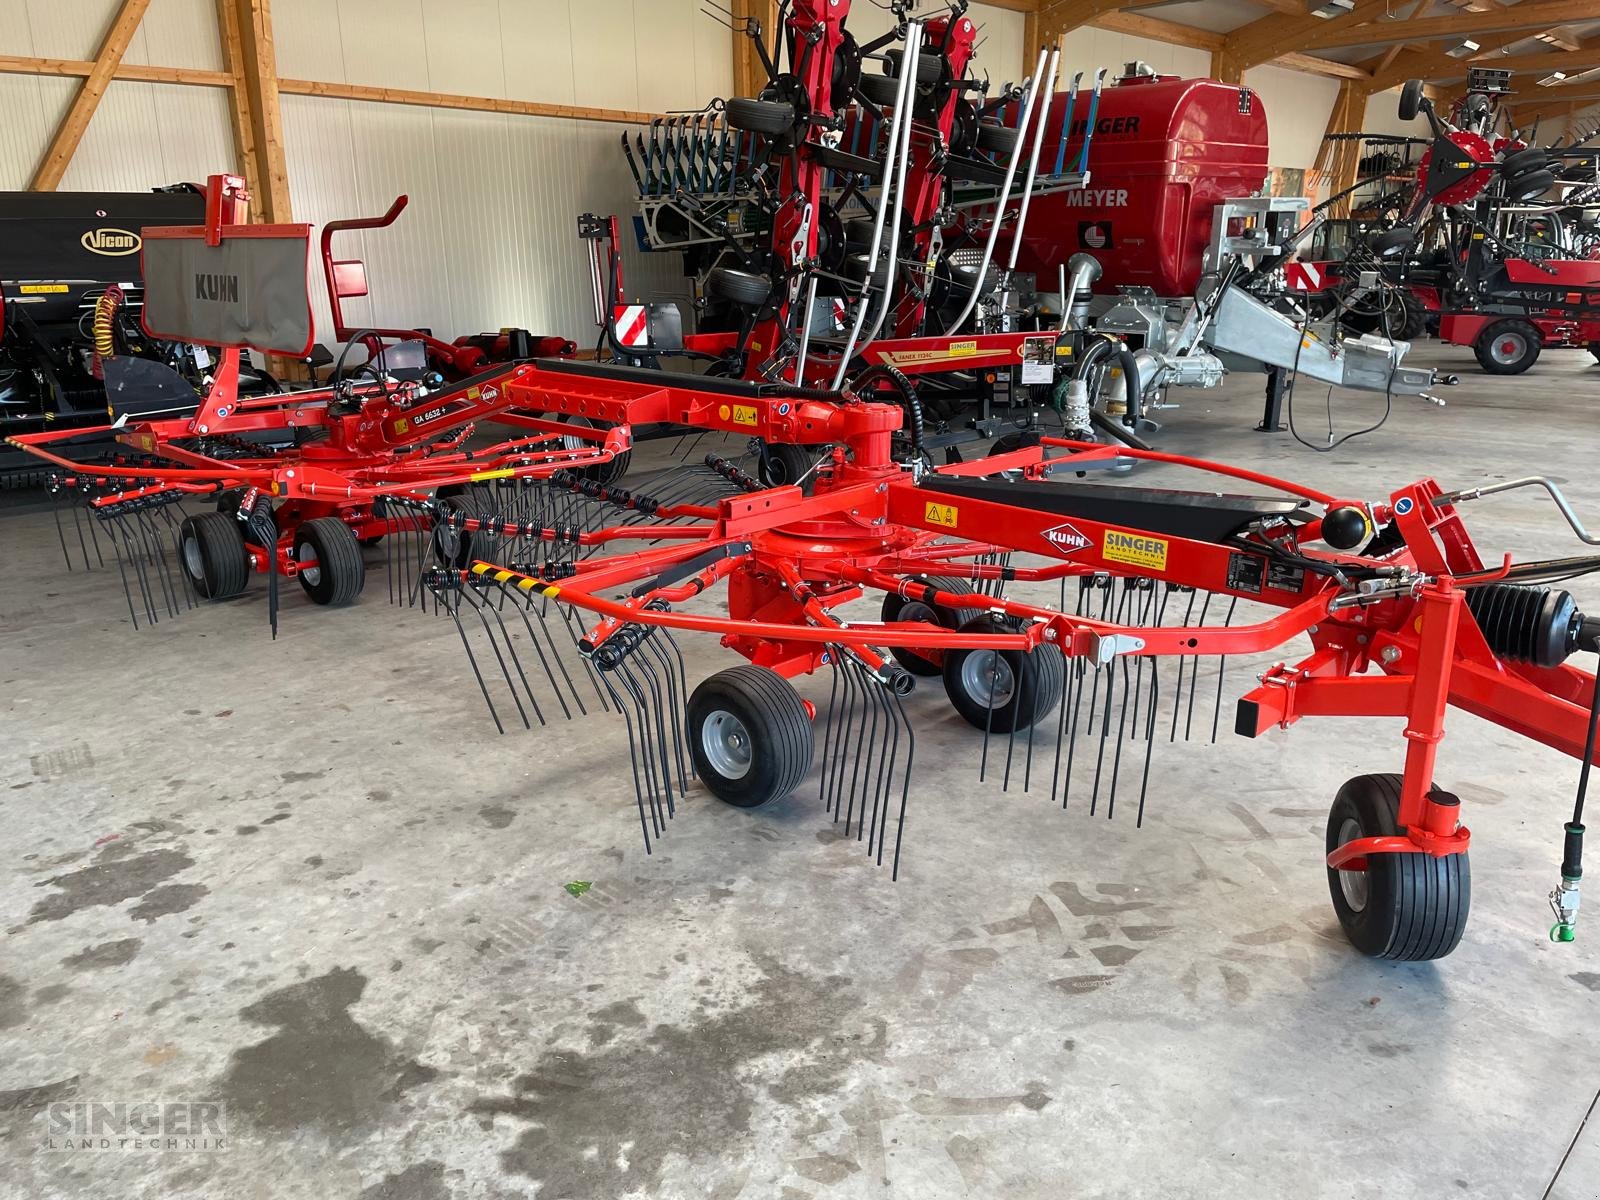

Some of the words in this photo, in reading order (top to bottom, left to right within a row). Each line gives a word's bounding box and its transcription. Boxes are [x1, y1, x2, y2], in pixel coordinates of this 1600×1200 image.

[1066, 189, 1128, 207] MEYER
[90, 230, 134, 248] Vicon
[195, 273, 239, 303] KUHN
[951, 342, 975, 350] SINGER
[481, 389, 499, 401] KUHN
[414, 416, 425, 425] GA
[424, 408, 441, 420] 6632
[1049, 530, 1085, 547] KUHN
[1106, 533, 1165, 555] SINGER
[1105, 545, 1164, 560] LANDTECHNIK
